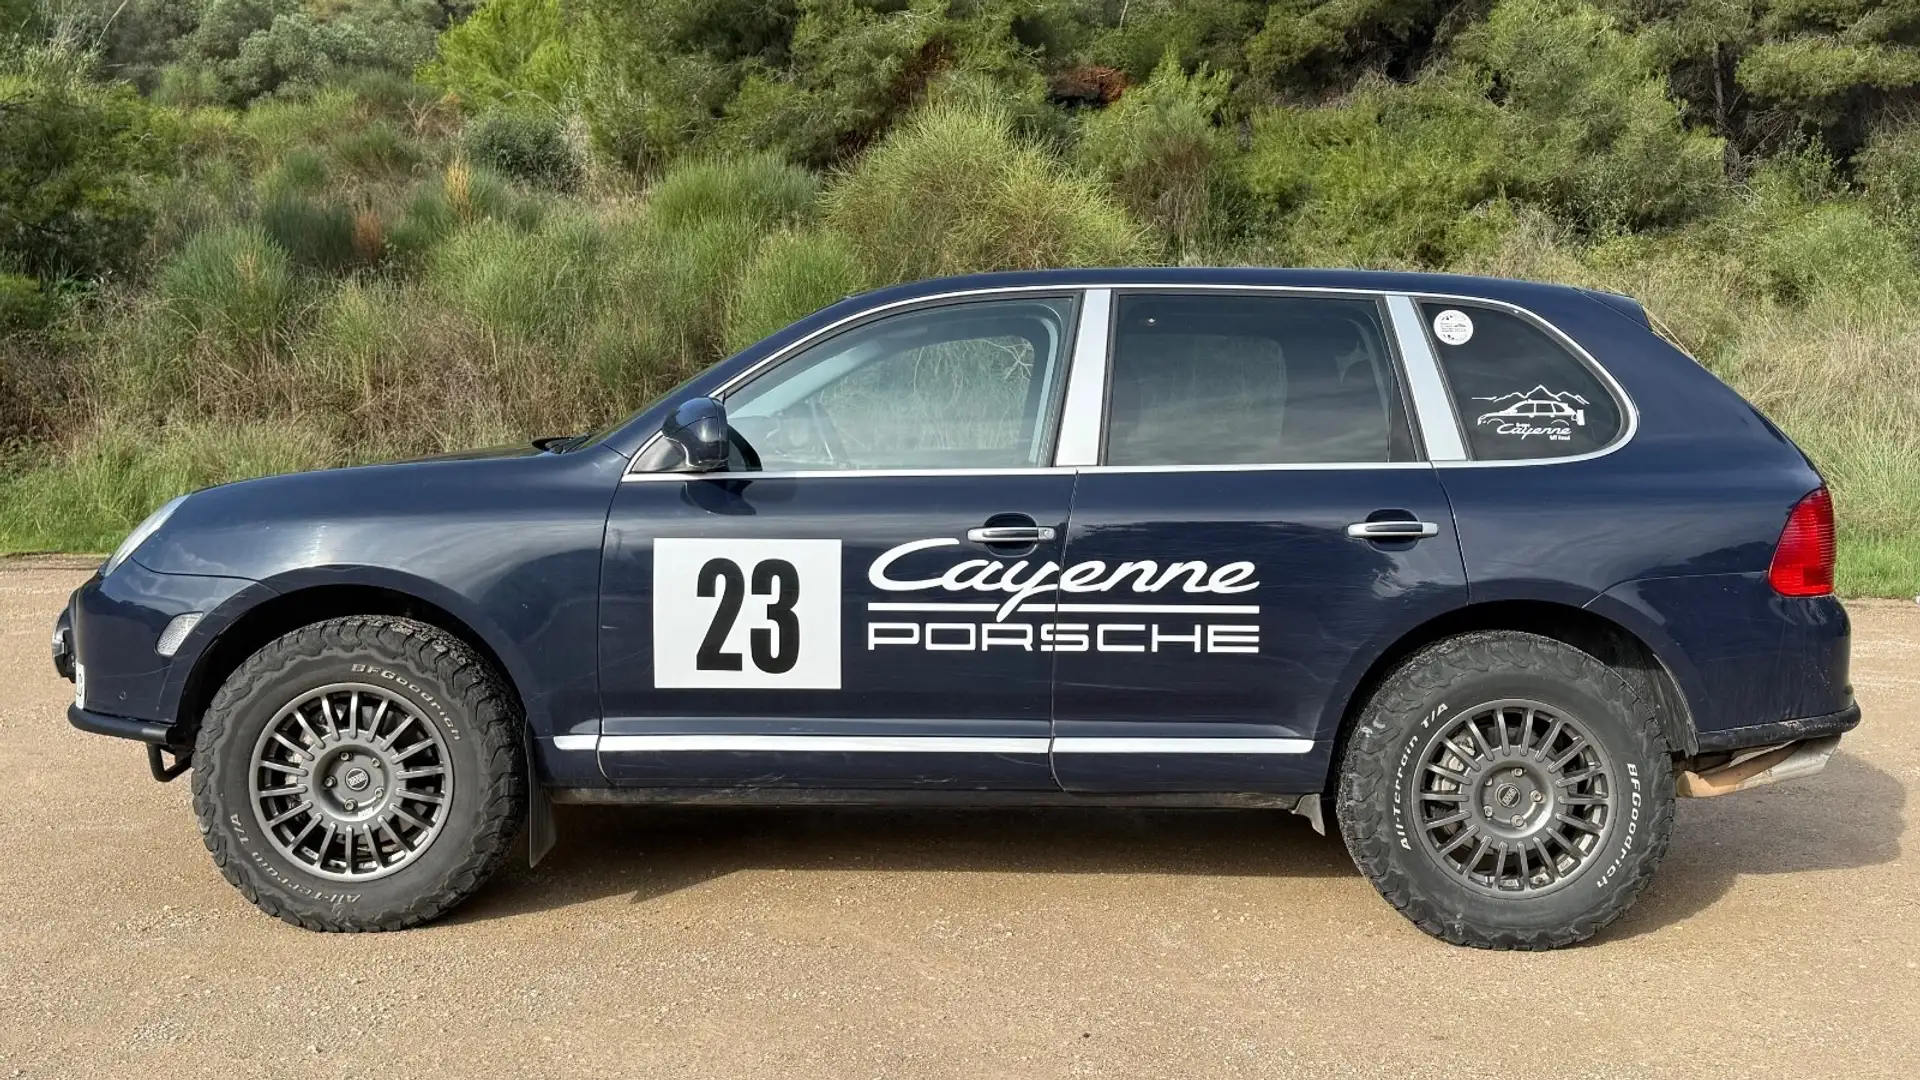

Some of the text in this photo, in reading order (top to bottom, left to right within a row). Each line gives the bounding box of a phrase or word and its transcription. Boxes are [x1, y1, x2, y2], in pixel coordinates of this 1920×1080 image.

[1497, 423, 1572, 440] Cayenne
[695, 557, 800, 674] 23
[867, 537, 1260, 623] Cayenne
[867, 622, 1260, 653] PORSCHE
[351, 663, 461, 741] BFGoodrich
[1393, 702, 1449, 851] All-Terrain T/A
[230, 812, 250, 845] T/A
[1595, 762, 1642, 889] BFGoodrich
